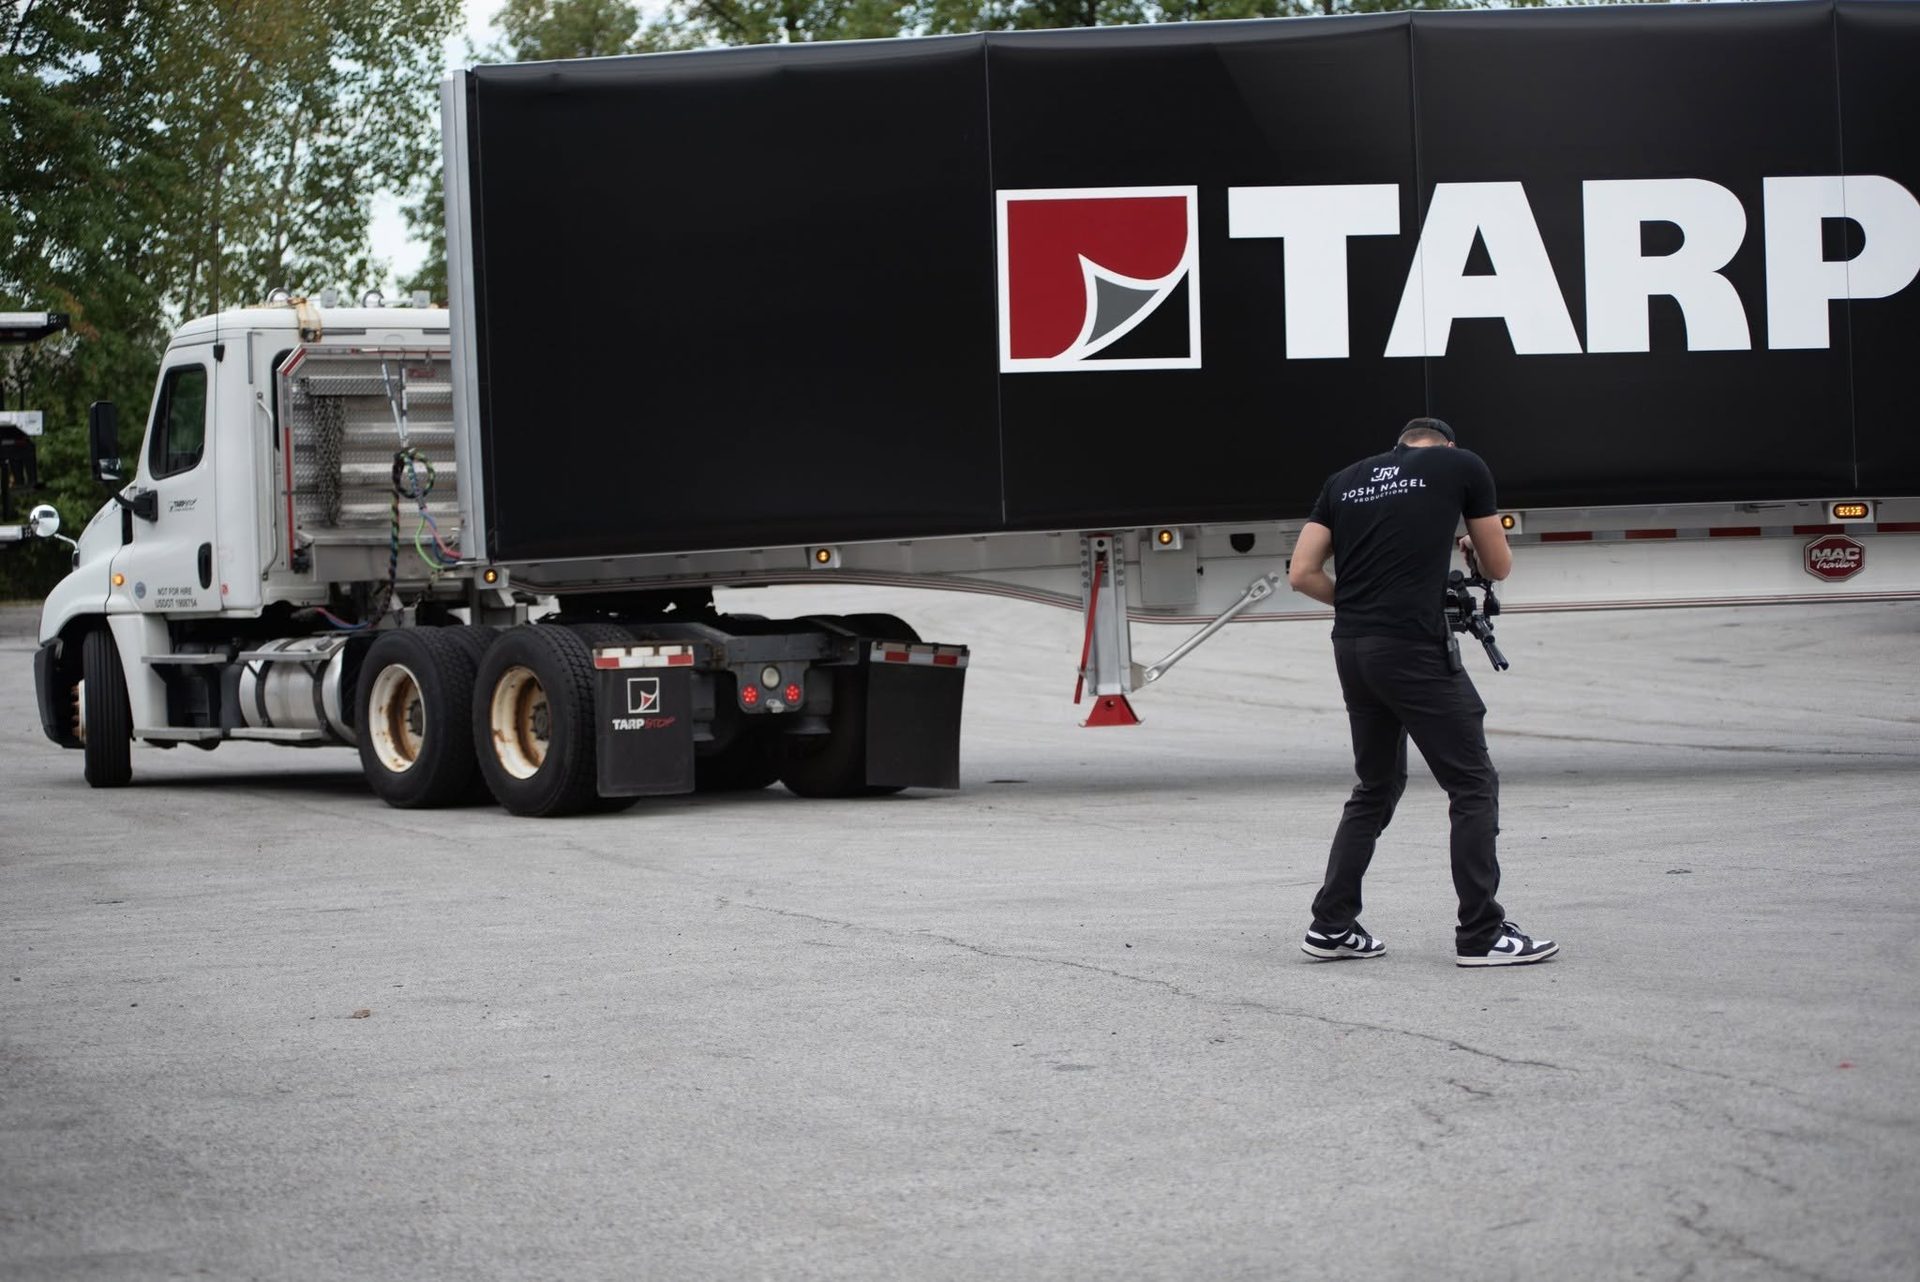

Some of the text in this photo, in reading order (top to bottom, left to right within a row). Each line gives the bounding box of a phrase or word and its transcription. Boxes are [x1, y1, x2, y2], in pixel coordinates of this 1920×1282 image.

[1228, 174, 1920, 359] TARP
[1341, 478, 1427, 501] JOSH NAGEL
[1354, 488, 1409, 503] PRODUCTIONS
[1811, 547, 1860, 561] MAC
[1816, 557, 1857, 569] Trailer
